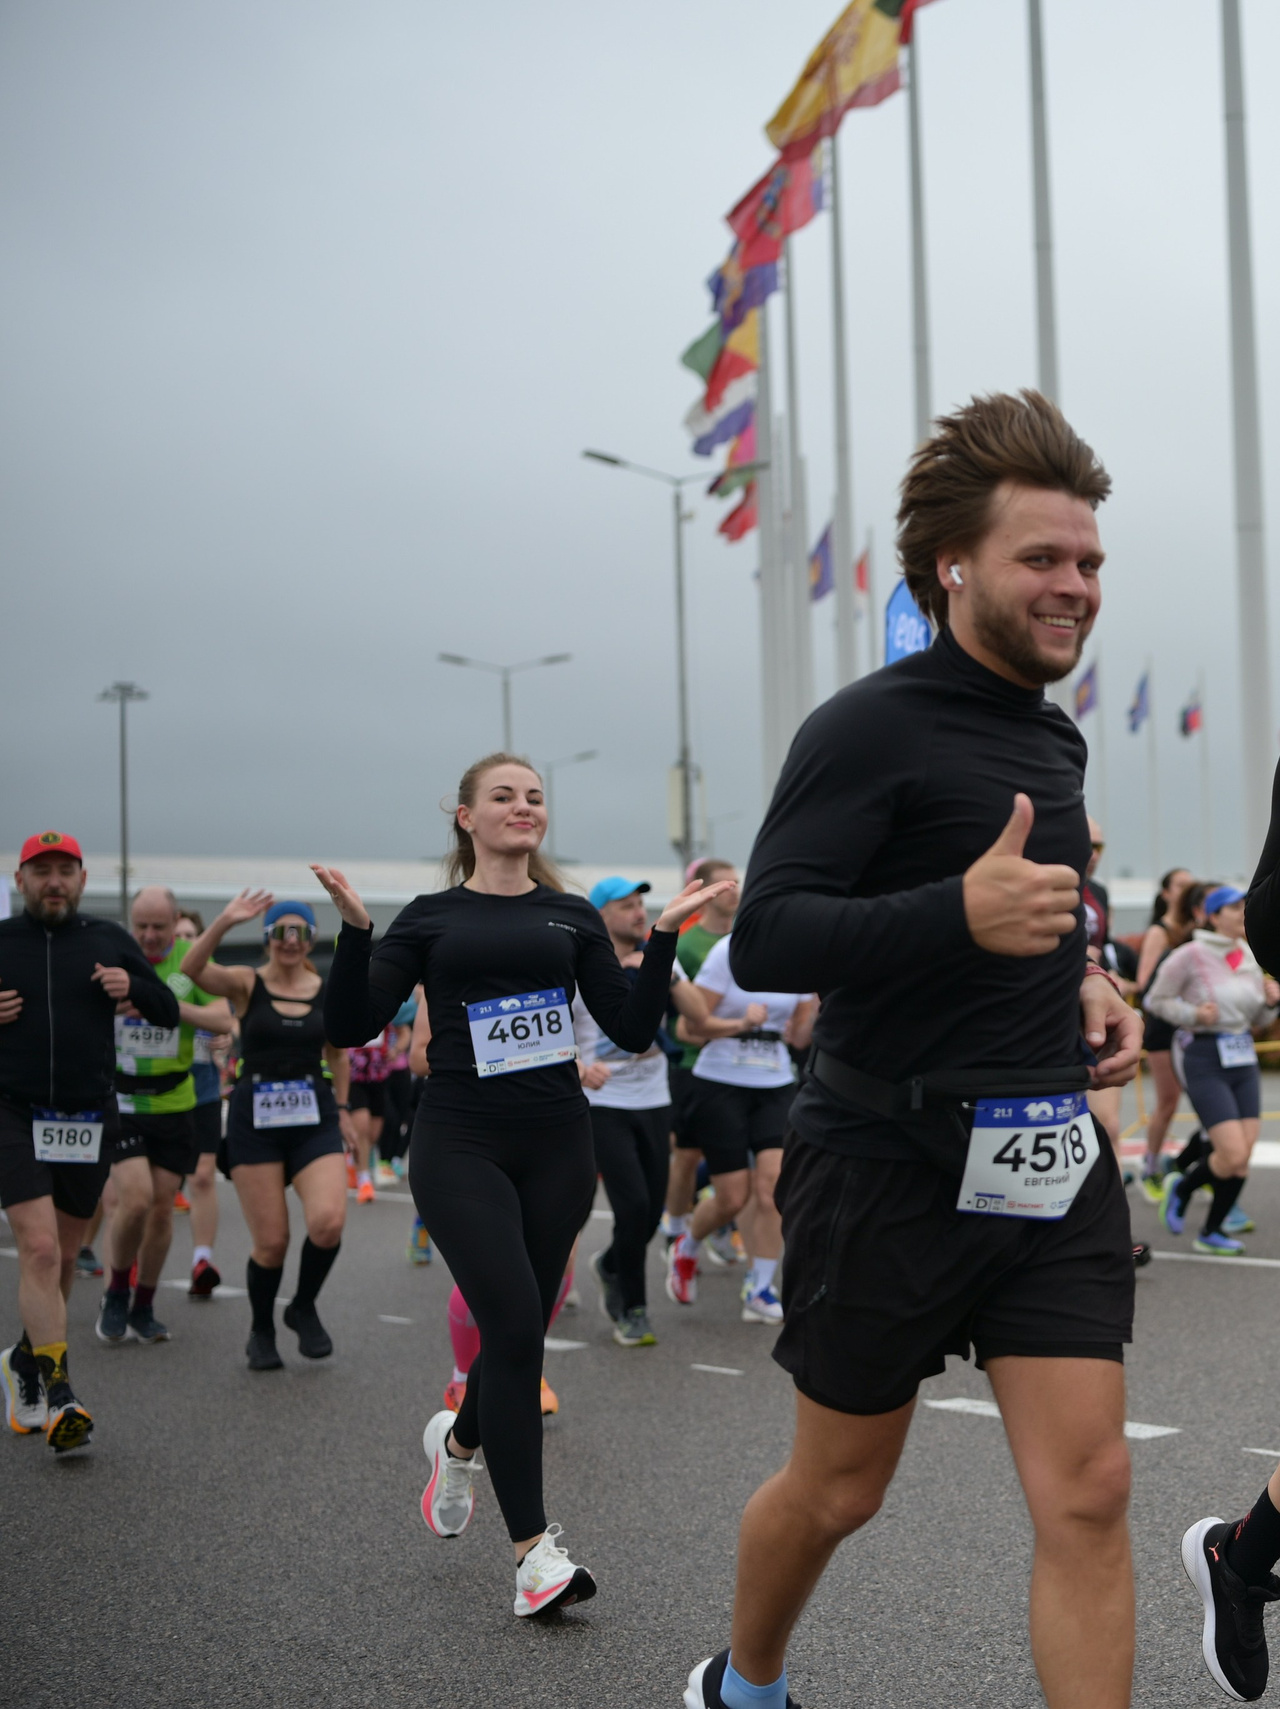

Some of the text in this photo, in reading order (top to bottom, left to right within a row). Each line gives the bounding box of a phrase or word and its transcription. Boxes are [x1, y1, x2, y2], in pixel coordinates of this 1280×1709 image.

[480, 1006, 492, 1014] 21.1
[487, 1009, 563, 1044] 4618
[517, 1040, 541, 1050] ЮЛИЯ
[993, 1108, 1013, 1118] 21.1
[42, 1127, 92, 1147] 5180
[992, 1123, 1088, 1172] 4518
[1024, 1172, 1071, 1187] ЕВГЕНИЙ
[975, 1198, 988, 1209] D
